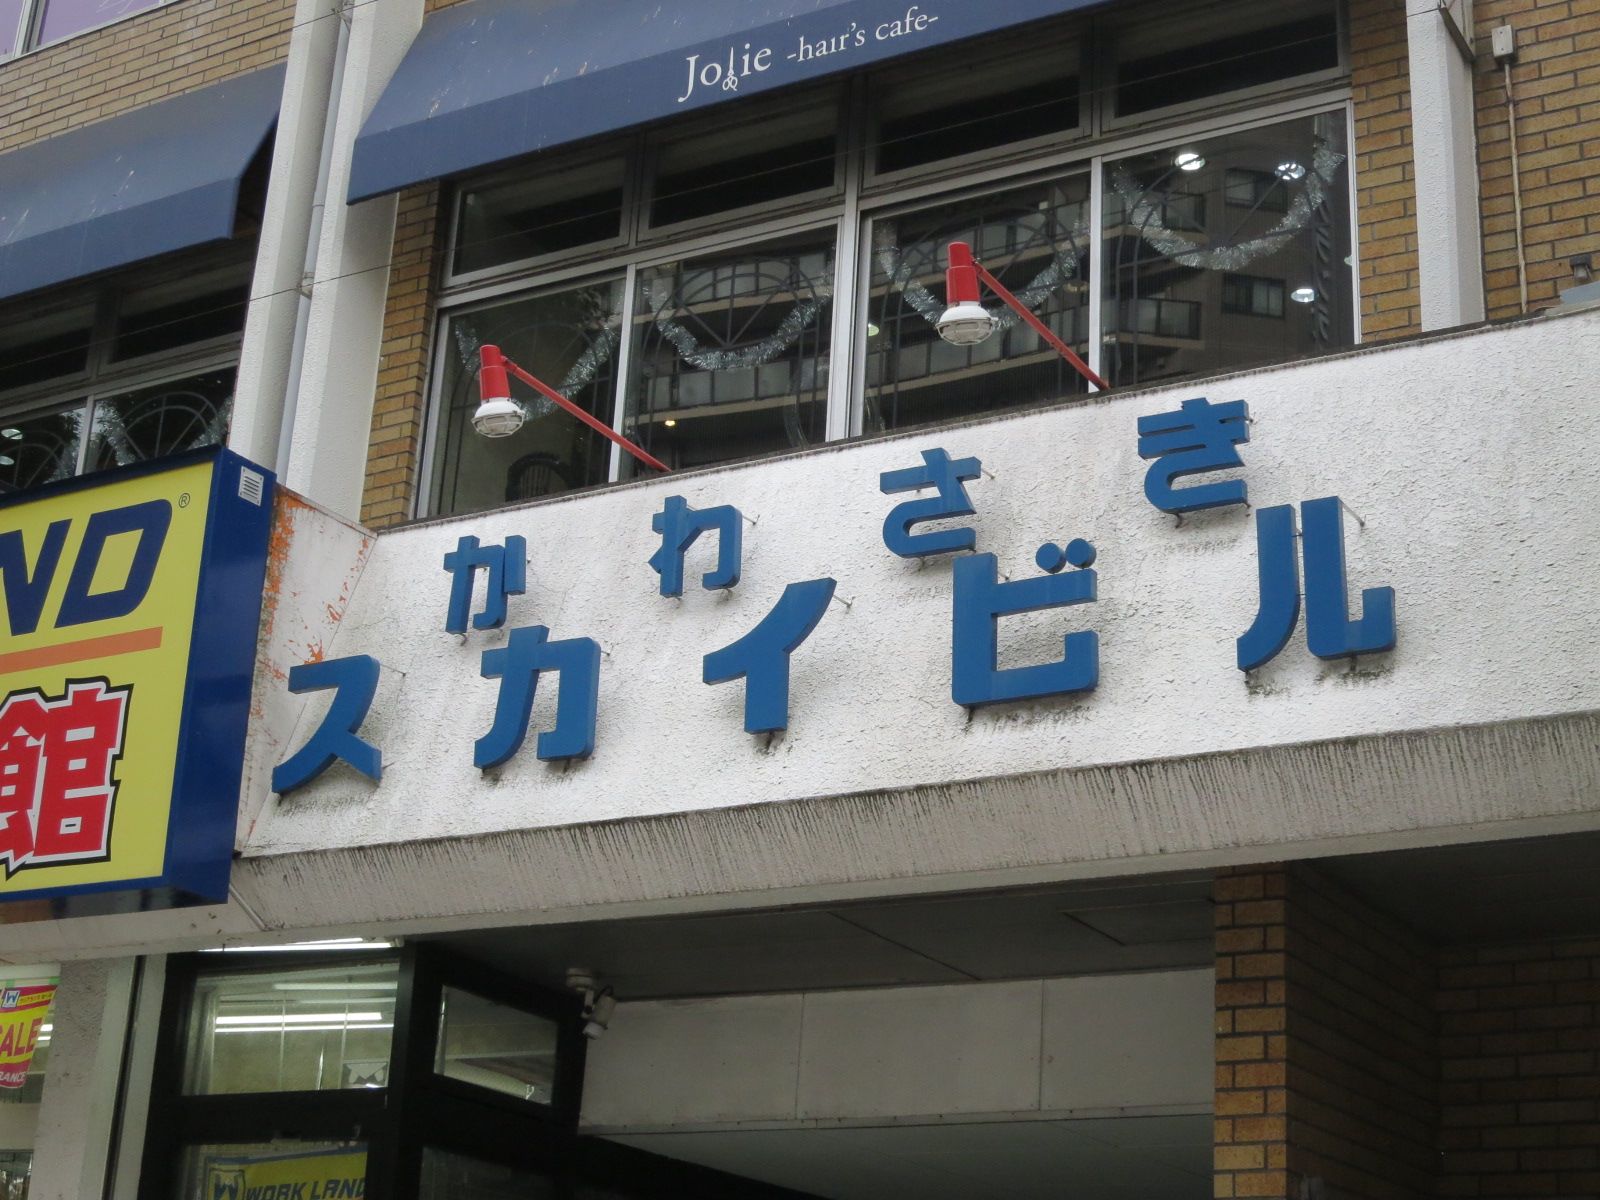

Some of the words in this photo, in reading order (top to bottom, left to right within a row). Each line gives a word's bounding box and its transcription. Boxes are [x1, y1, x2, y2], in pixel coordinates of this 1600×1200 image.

[677, 43, 773, 103] Jolie
[443, 397, 1252, 635] かわさき
[271, 495, 1397, 795] スカイビル
[0, 1018, 42, 1057] ALE
